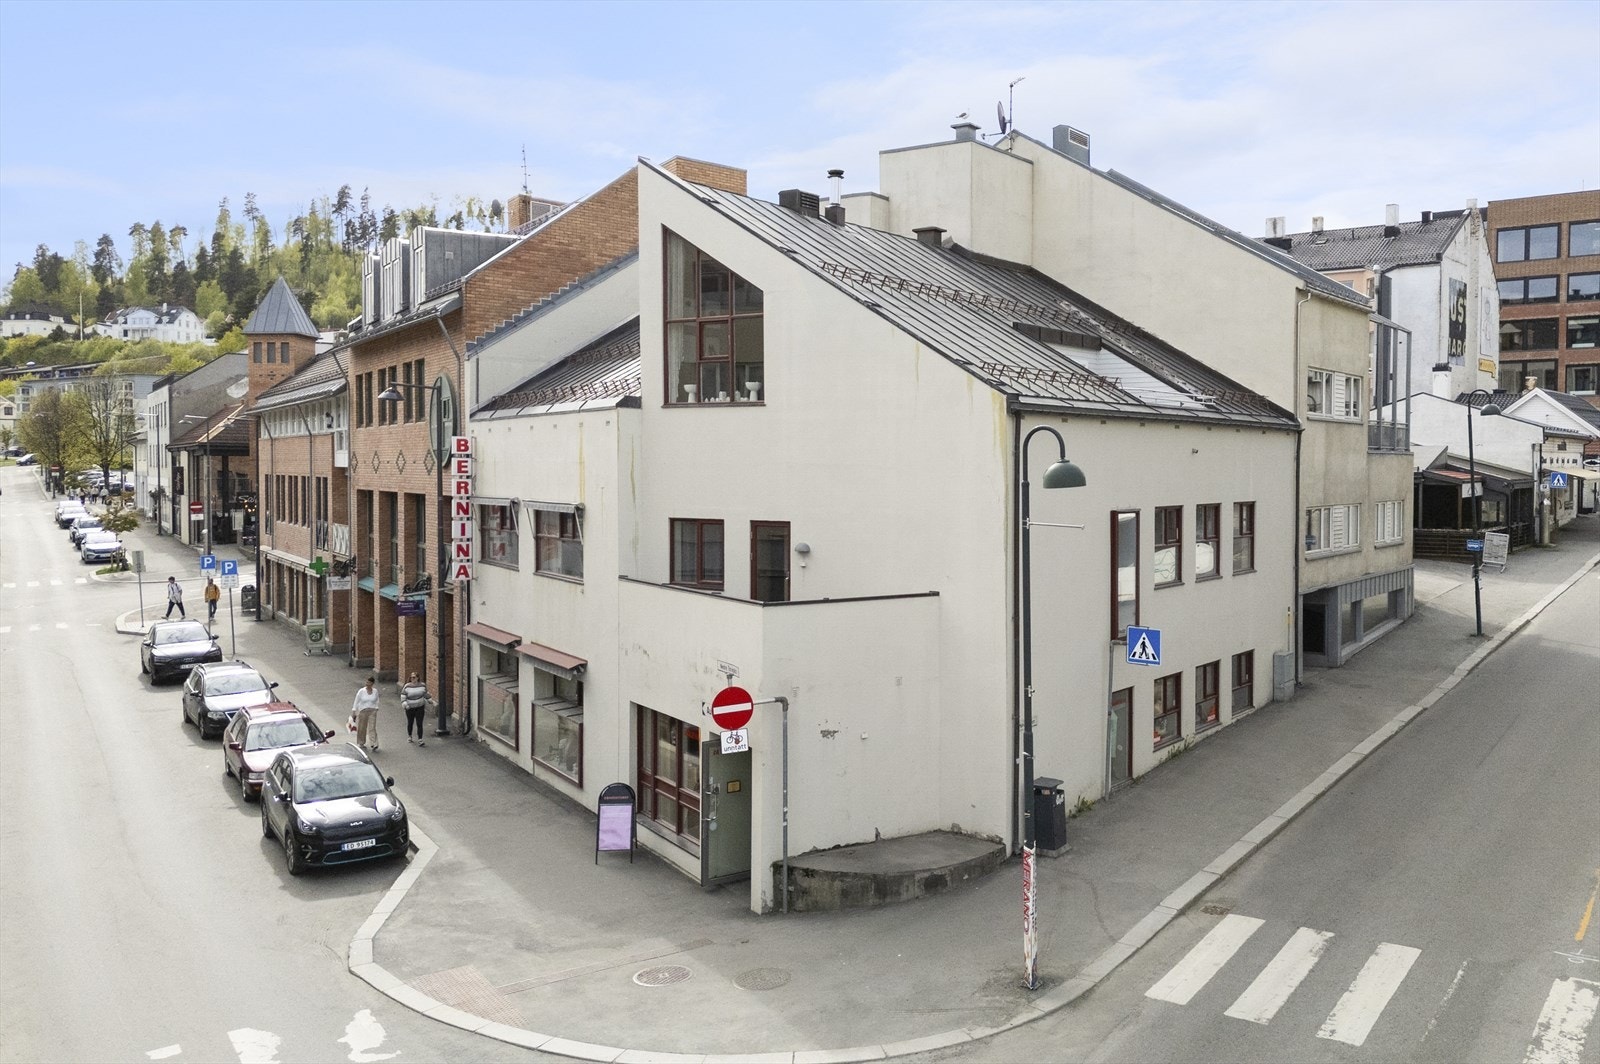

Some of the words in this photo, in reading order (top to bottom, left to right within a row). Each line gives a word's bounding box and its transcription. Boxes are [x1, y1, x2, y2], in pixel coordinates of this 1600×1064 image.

[455, 438, 470, 579] BERNINA
[204, 557, 212, 568] P
[224, 562, 234, 573] P
[724, 744, 746, 752] unntatt
